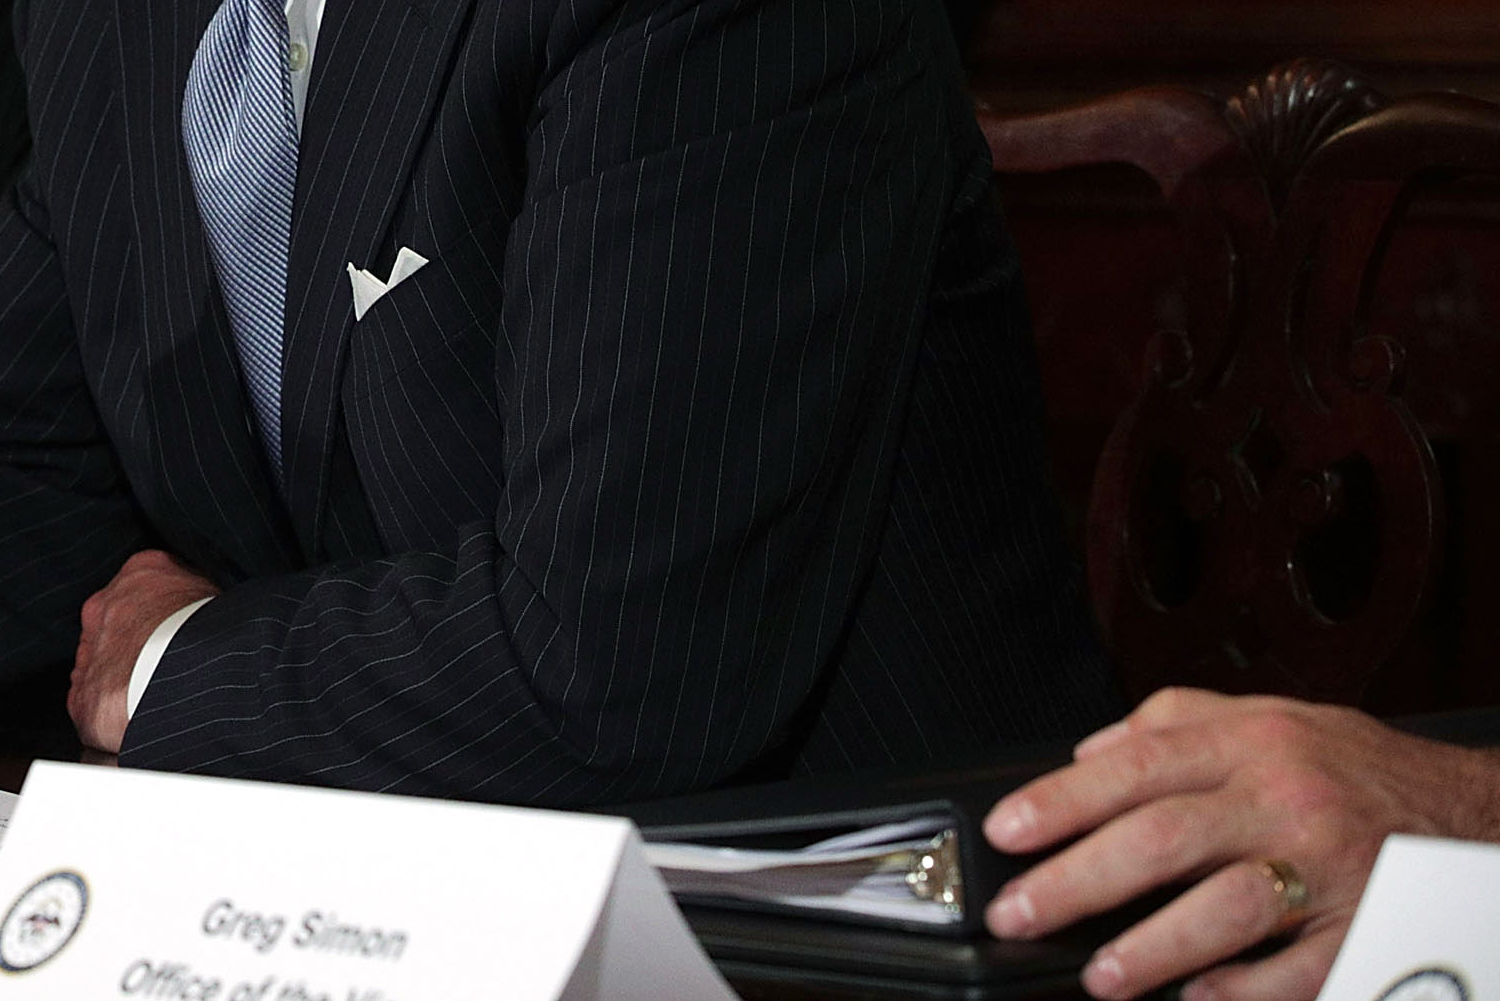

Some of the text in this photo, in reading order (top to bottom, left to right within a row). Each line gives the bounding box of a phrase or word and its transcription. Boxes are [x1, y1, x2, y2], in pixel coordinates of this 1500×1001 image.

[201, 898, 409, 962] Greg Simon
[118, 958, 222, 1001] Office
